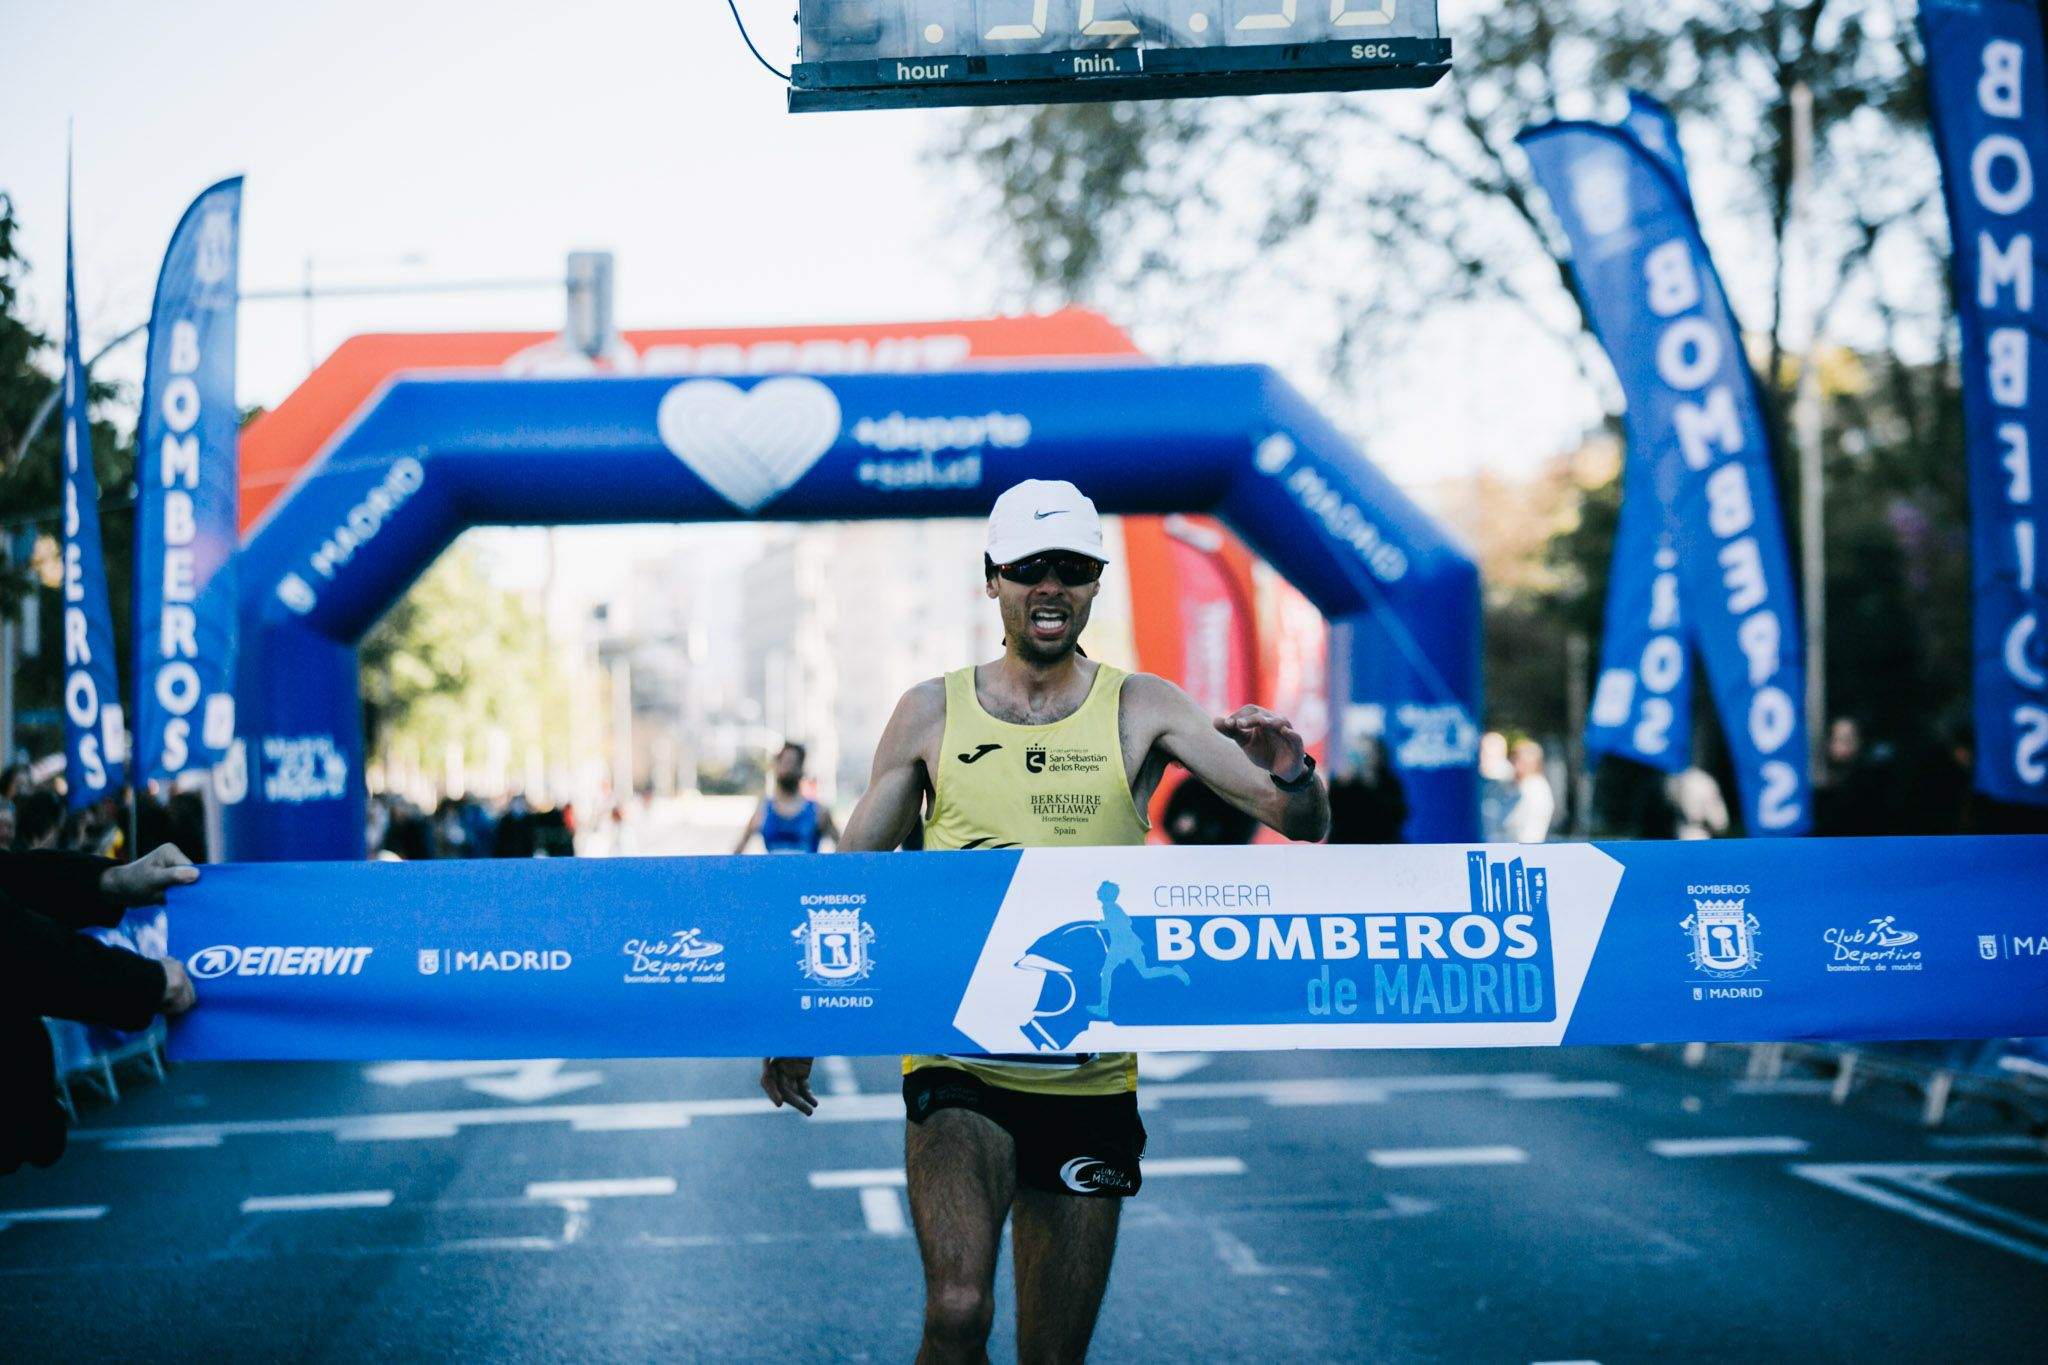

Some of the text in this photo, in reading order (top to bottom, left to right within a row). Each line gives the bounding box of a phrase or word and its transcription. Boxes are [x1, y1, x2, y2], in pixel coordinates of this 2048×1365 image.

[897, 43, 1397, 80] hour min. sec.
[310, 456, 425, 578] MADRID
[155, 319, 201, 773] BOMBEROS
[1049, 753, 1065, 763] San
[1048, 763, 1100, 773] de los Reyes
[1031, 794, 1101, 804] BERKSHIRE
[1033, 804, 1098, 814] HATHAWAY
[1053, 826, 1077, 835] Spain
[1154, 884, 1271, 907] CARRERA
[1686, 884, 1751, 895] BOMBEROS
[800, 894, 867, 906] BOMBEROS
[1155, 914, 1539, 962] BOMBEROS
[1823, 928, 1865, 943] Club
[623, 938, 669, 955] Club
[1833, 942, 1922, 965] Deportivo
[237, 946, 373, 976] ENERVIT
[456, 950, 573, 972] MADRID
[632, 953, 726, 976] Deportivo
[1826, 962, 1922, 972] bomberos de madrid
[1307, 963, 1544, 1016] de MADRID
[1709, 987, 1763, 999] MADRID
[818, 996, 873, 1008] MADRID
